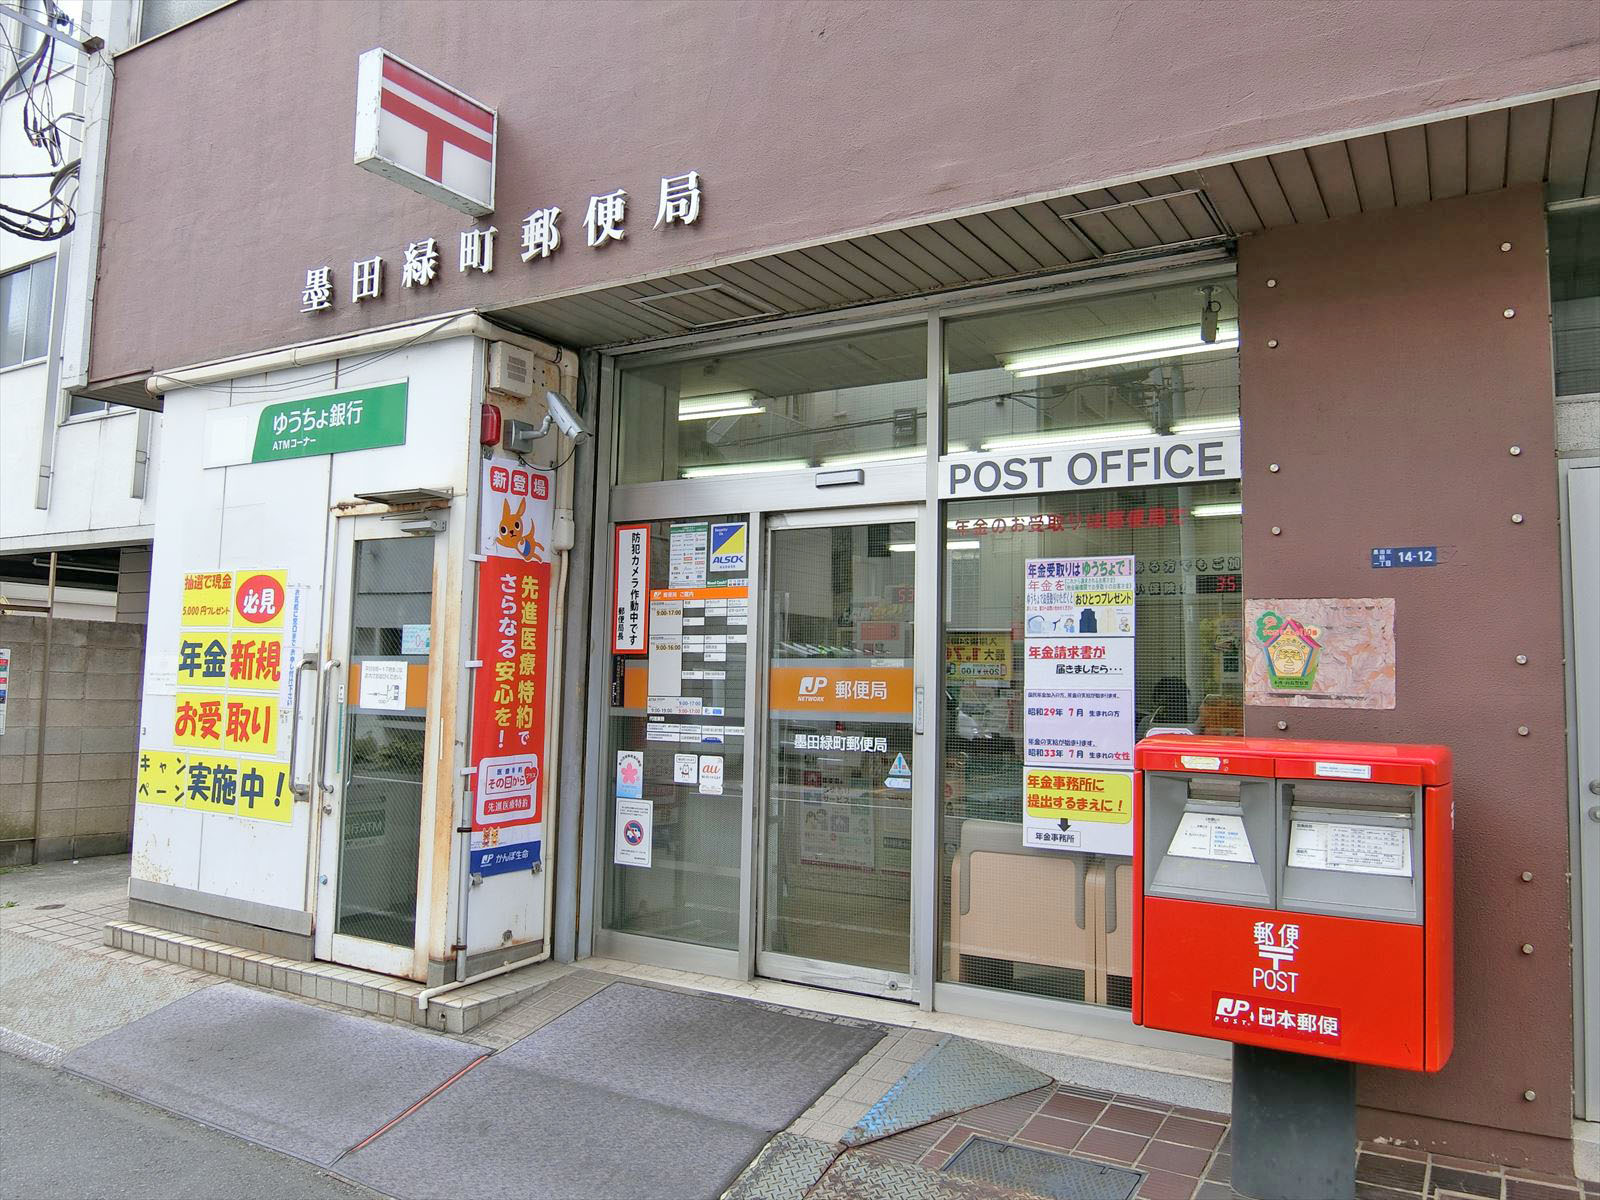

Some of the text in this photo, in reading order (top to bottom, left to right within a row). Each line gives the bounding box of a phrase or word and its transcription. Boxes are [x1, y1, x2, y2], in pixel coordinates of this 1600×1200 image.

[300, 170, 702, 314] 墨田緑町郵便局
[273, 400, 363, 435] ゆうちょ銀行
[272, 437, 316, 450] ATMコーナー
[950, 441, 1225, 494] POST OFFICE
[492, 470, 547, 497] 新登場
[712, 555, 744, 564] ALSOK
[1398, 550, 1432, 563] 14-12
[184, 574, 231, 590] 抽選で現金
[629, 532, 641, 645] 防犯カメラ作動中です
[1029, 580, 1064, 592] 年金を
[243, 588, 275, 614] 必見
[1075, 593, 1132, 606] おひとつプレゼント
[617, 607, 625, 640] 郵便局長
[178, 639, 281, 682] 年金新規
[494, 573, 517, 748] さらなる安心を！
[516, 575, 540, 746] 先進医療特約で
[1029, 646, 1106, 660] 年金請求書が
[835, 680, 887, 700] 郵便局
[174, 701, 271, 744] お受取り
[1028, 708, 1063, 717] 昭和29年
[794, 733, 888, 753] 墨田緑町郵便局
[140, 755, 186, 775] キャン
[1028, 749, 1064, 758] 昭和33年
[1089, 751, 1131, 761] 生まれの女性
[702, 763, 721, 774] au
[188, 762, 285, 808] 実施中！
[488, 776, 525, 789] その日から
[1027, 776, 1105, 792] 年金事務所に
[139, 784, 185, 802] ペーン
[1027, 794, 1124, 813] 提出するまえに！
[1035, 832, 1075, 843] 年金事務所
[496, 849, 530, 864] かんぽ生命
[1253, 922, 1300, 950] 郵便
[1252, 968, 1299, 993] POST
[1258, 1007, 1339, 1037] 日本郵便
